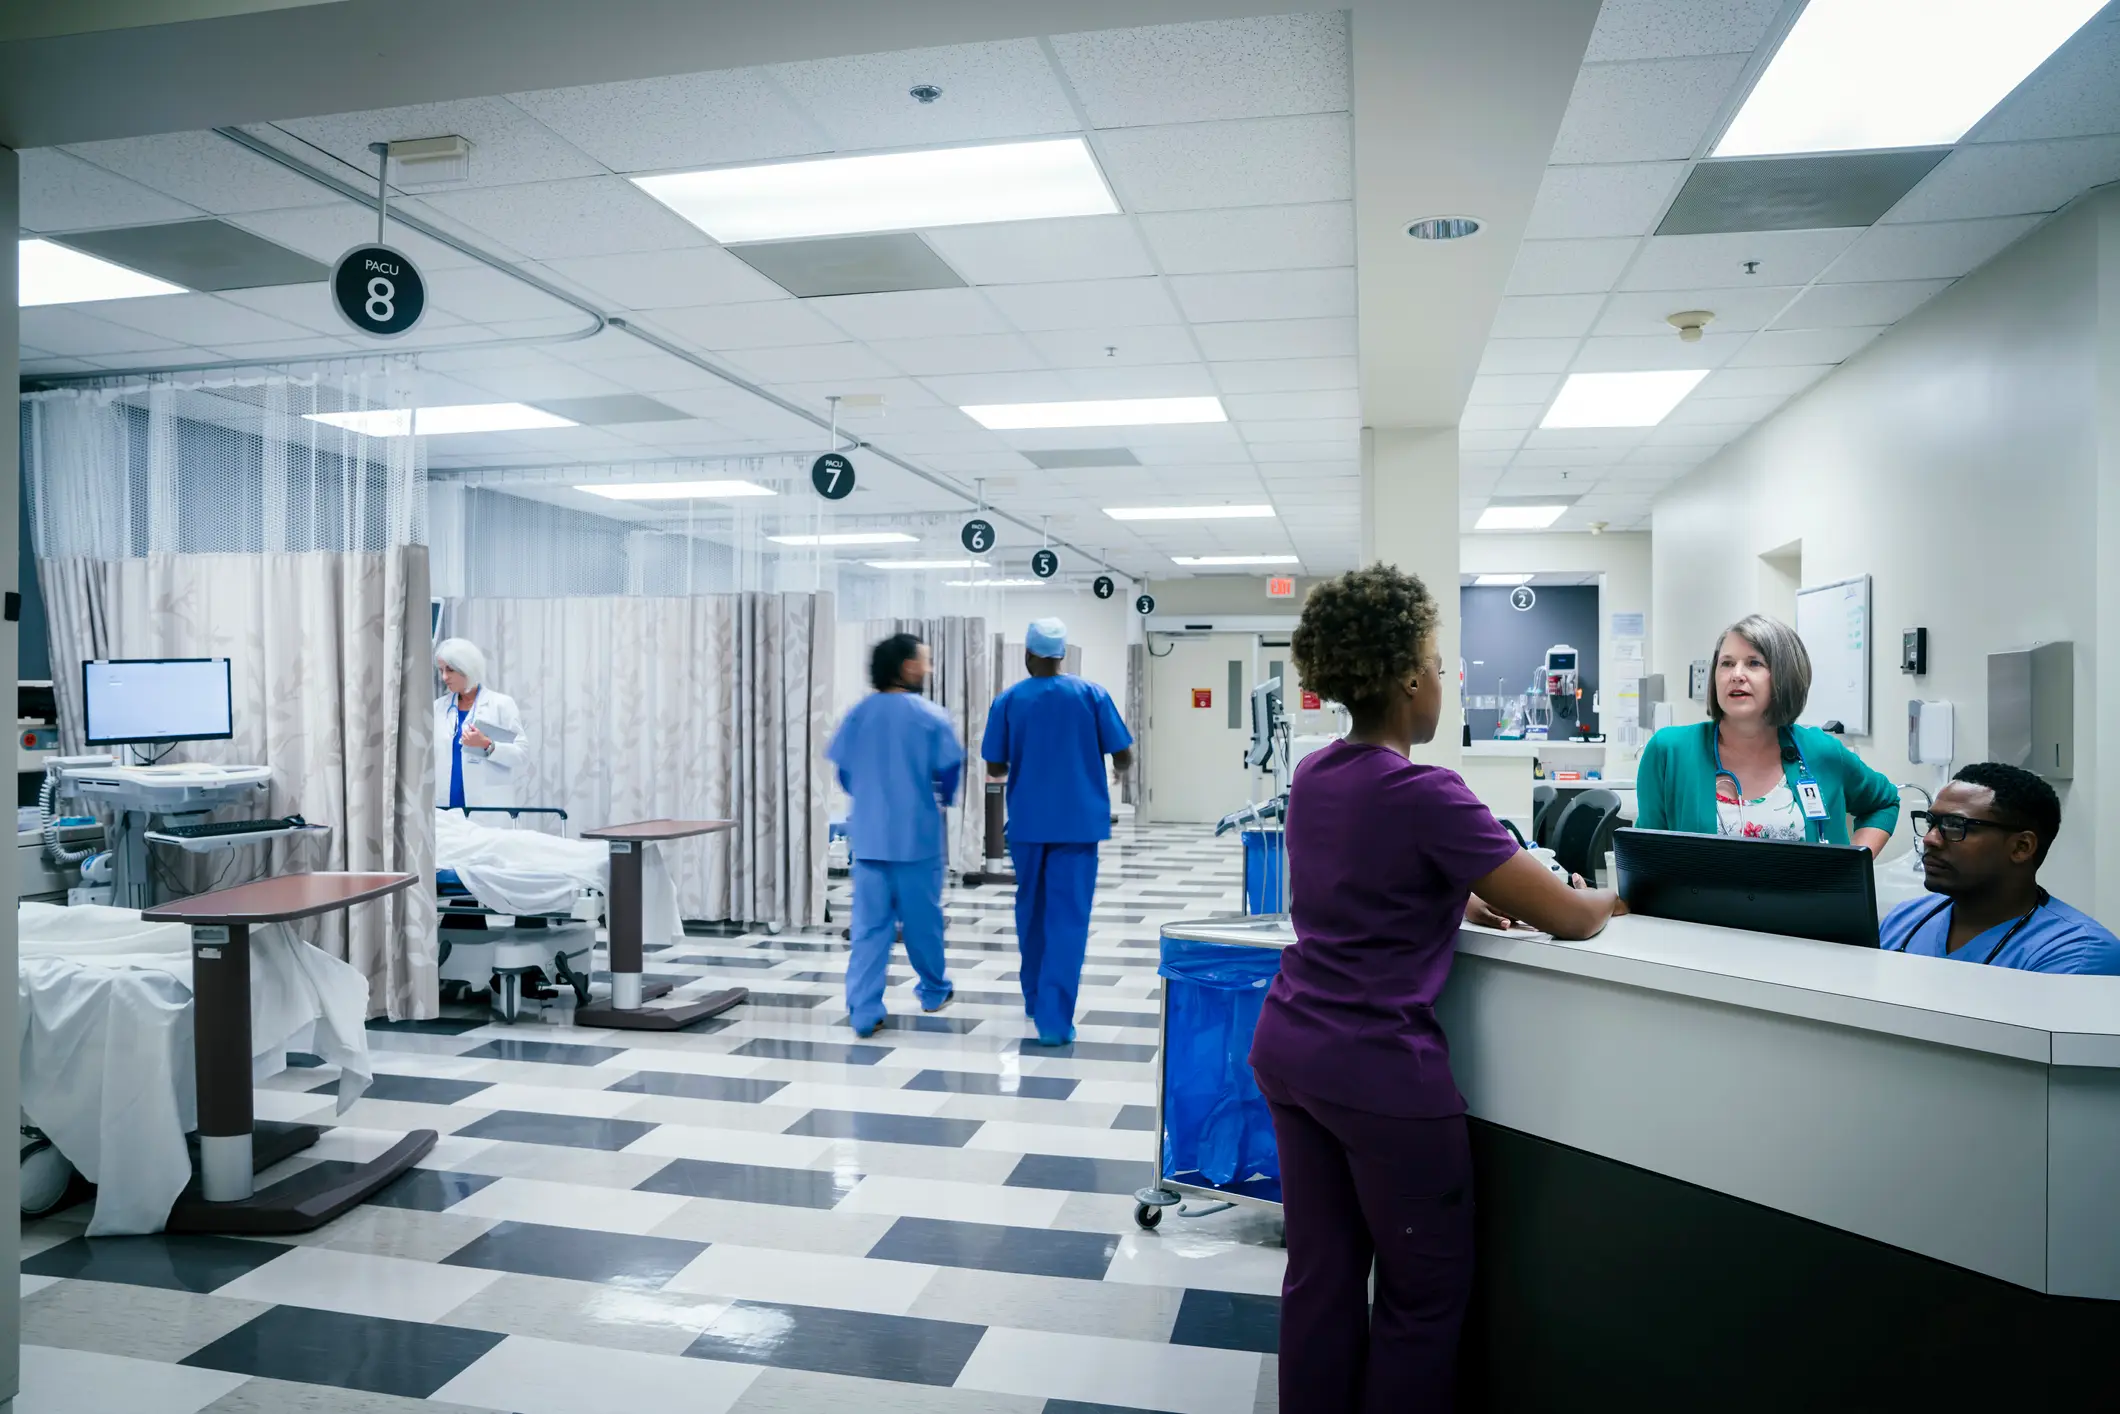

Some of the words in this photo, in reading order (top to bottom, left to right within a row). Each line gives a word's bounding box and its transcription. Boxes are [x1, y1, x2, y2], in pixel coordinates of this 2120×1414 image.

[365, 259, 399, 276] PACU
[365, 277, 395, 322] 8
[825, 459, 843, 468] PACU
[826, 468, 842, 493] 7
[972, 530, 984, 549] 6
[1039, 558, 1049, 575] 5
[1100, 583, 1108, 597] 4
[1271, 578, 1292, 594] EXIT
[1141, 601, 1149, 613] 3
[1518, 595, 1526, 607] 2
